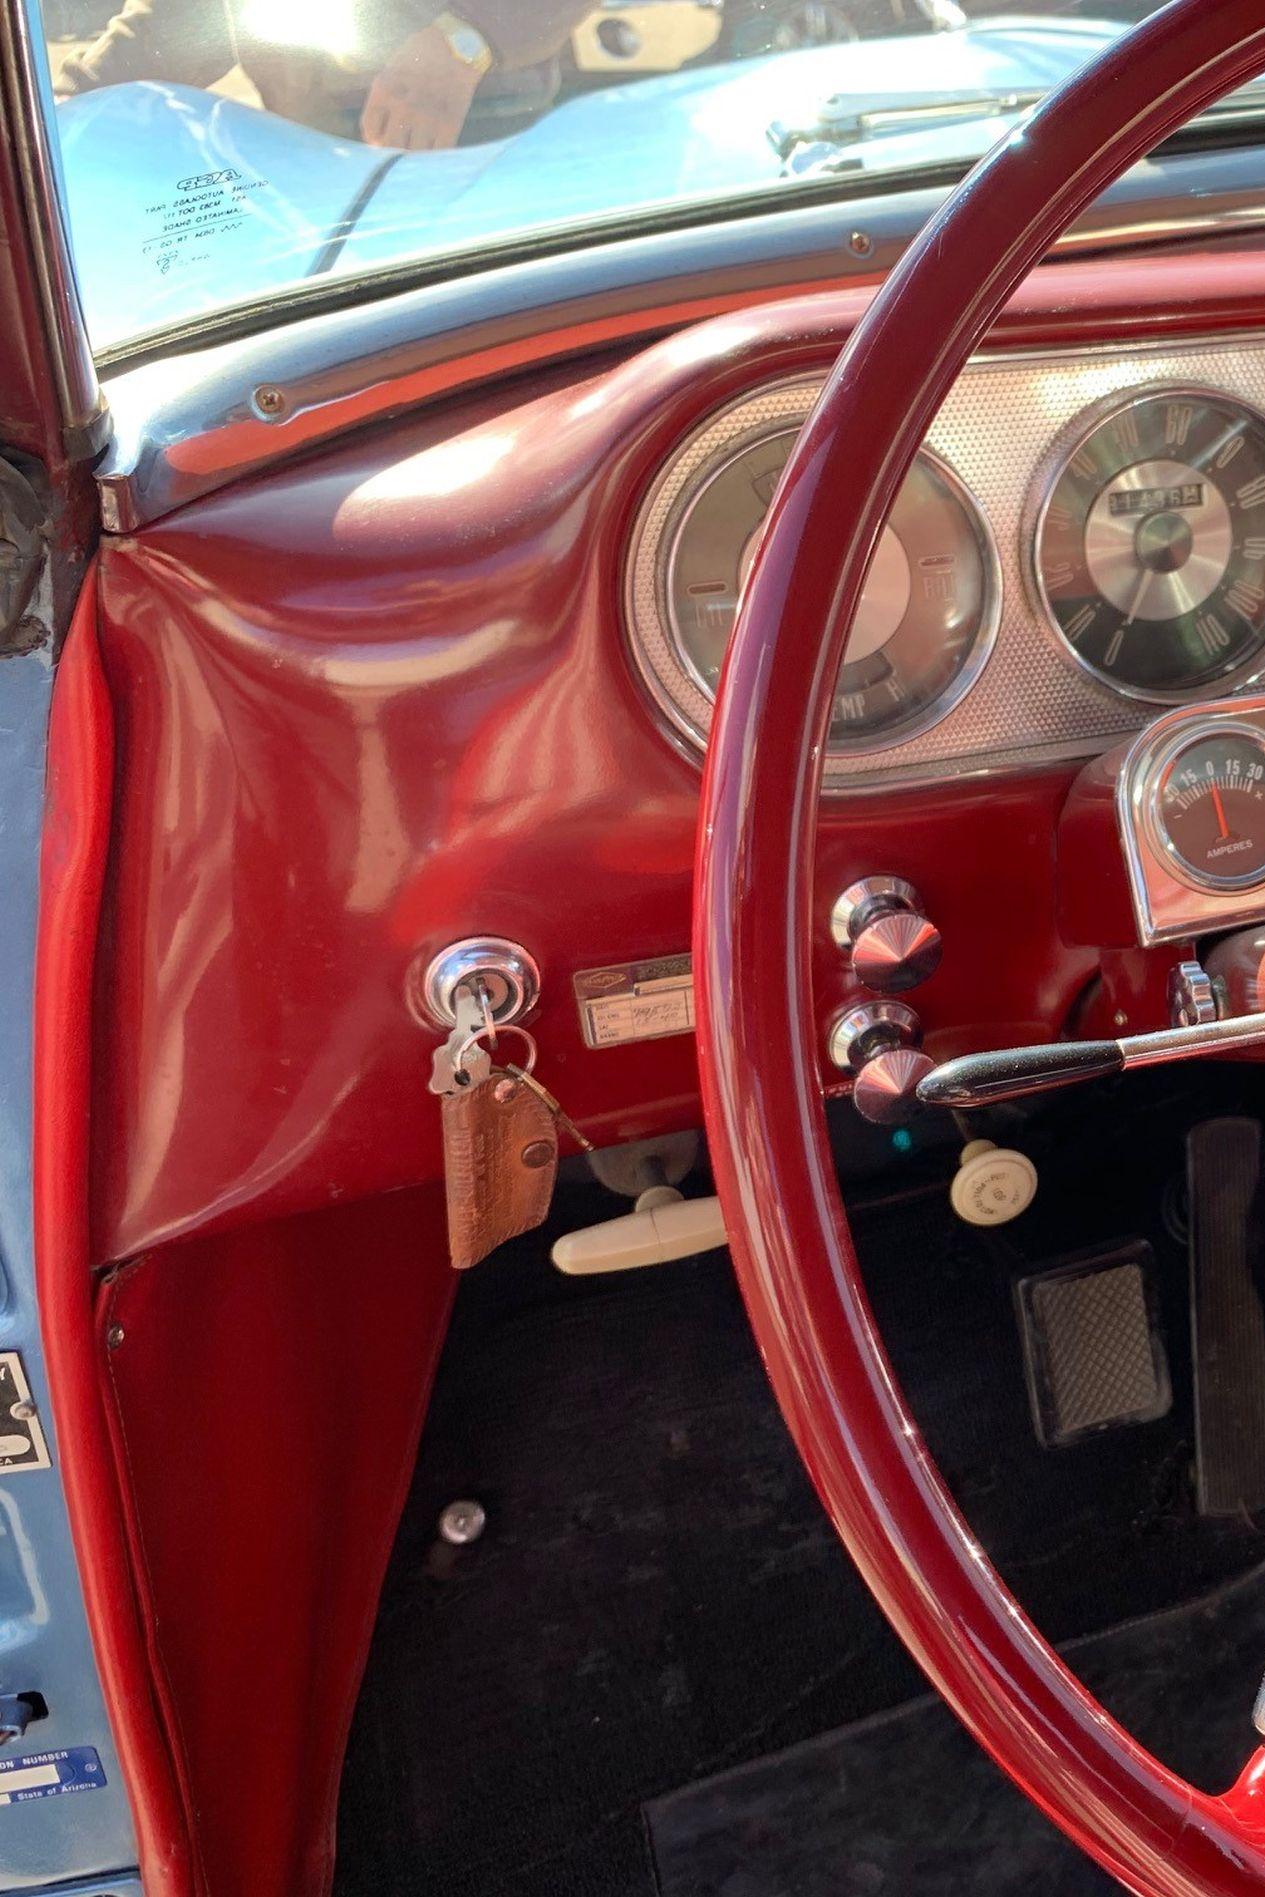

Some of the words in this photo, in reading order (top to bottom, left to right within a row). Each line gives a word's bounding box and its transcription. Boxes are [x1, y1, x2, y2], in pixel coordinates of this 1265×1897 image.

[1104, 628, 1125, 667] 0
[832, 692, 866, 721] EMP
[1180, 768, 1198, 787] 15
[1205, 760, 1215, 777] 0
[1225, 758, 1241, 776] 15
[1246, 762, 1265, 781] 30
[1206, 838, 1254, 860] AMPERES
[22, 1751, 69, 1766] NUMBER
[17, 1790, 43, 1801] State
[47, 1788, 57, 1796] of
[61, 1782, 97, 1793] Arizona
